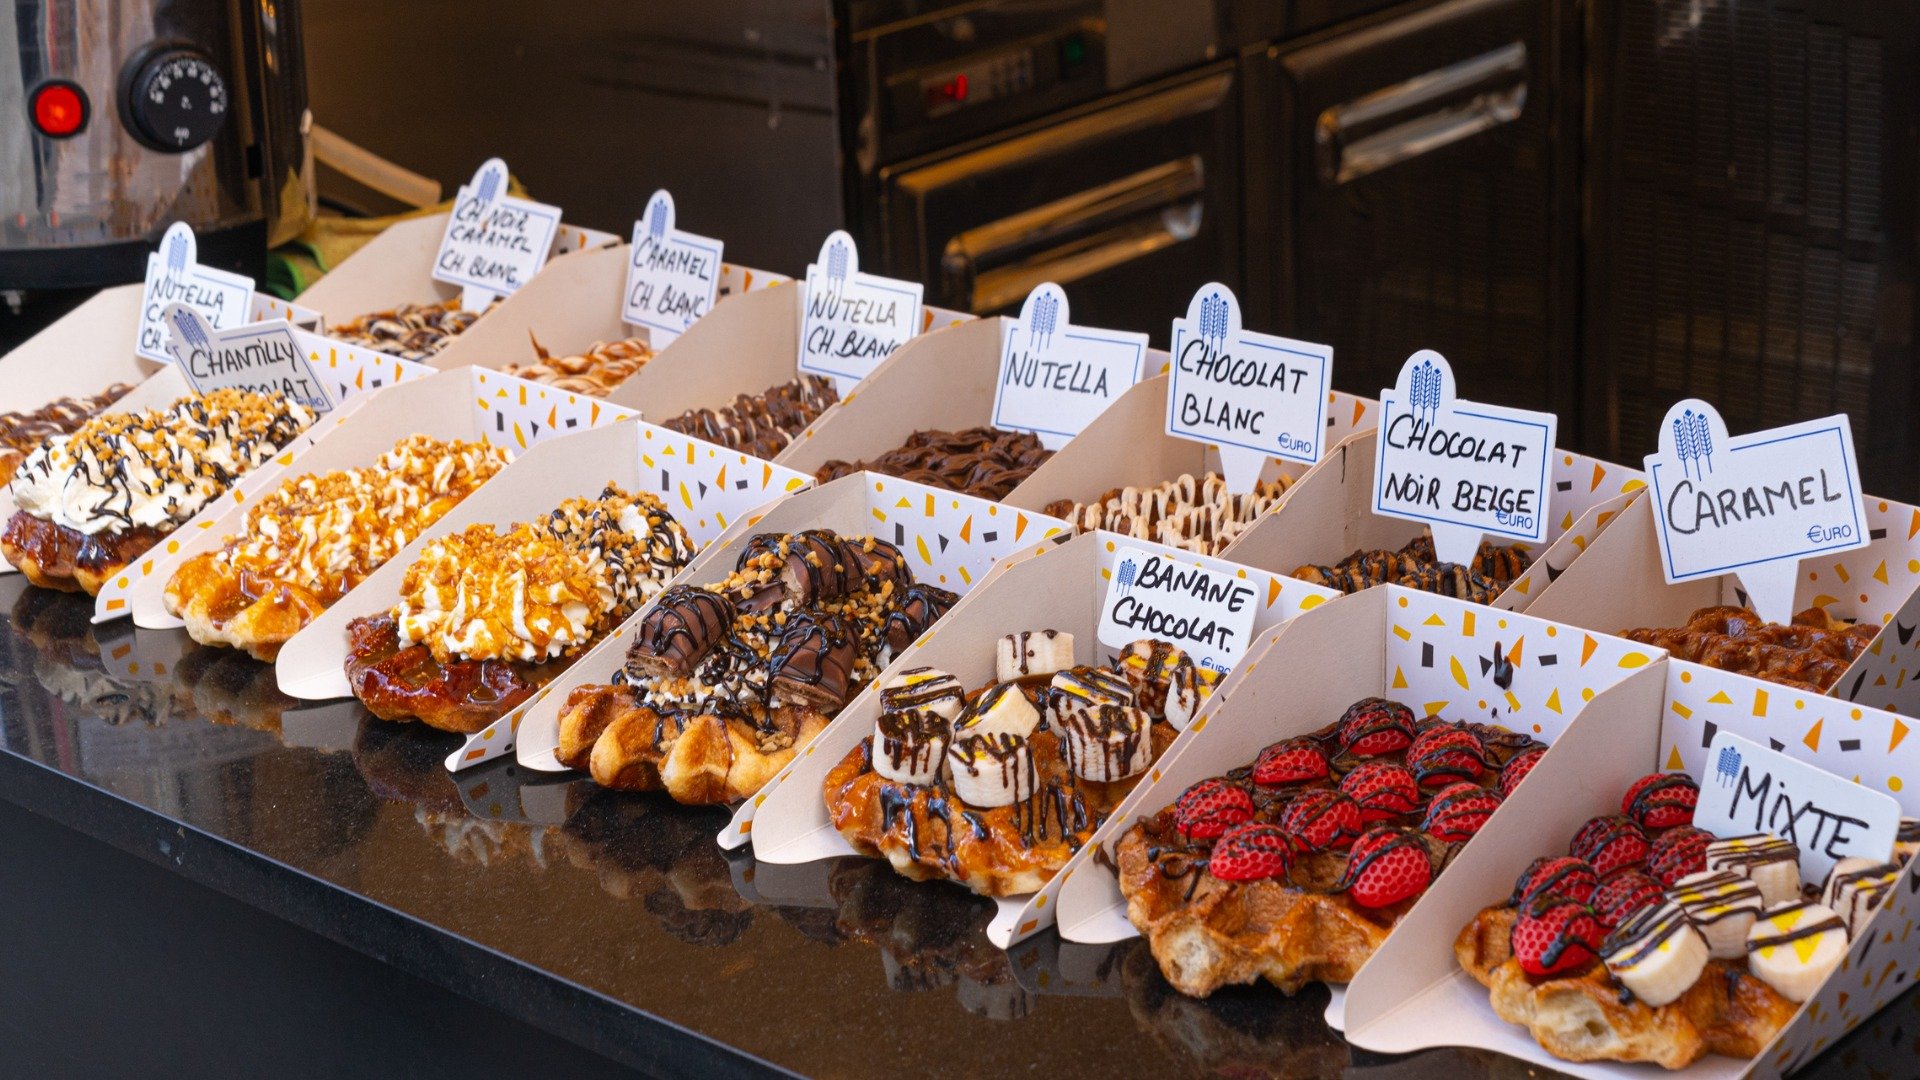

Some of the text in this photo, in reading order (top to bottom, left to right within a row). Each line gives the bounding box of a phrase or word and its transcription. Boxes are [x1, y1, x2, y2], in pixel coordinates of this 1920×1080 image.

[450, 225, 532, 254] CARAMEL
[633, 236, 709, 281] CARAMEL
[468, 255, 517, 283] BLANC
[151, 275, 225, 311] NUTELLA
[656, 284, 705, 318] BLANC
[809, 290, 897, 327] NUTELLA
[1006, 351, 1108, 397] NUTELLA
[1180, 340, 1308, 394] CHOCOLAT
[1181, 393, 1264, 434] BLANC
[1388, 414, 1527, 467] CHOCOLAT
[1452, 480, 1534, 513] BELGE
[1667, 468, 1842, 535] CARAMEL
[1135, 557, 1254, 612] BANANE
[1113, 596, 1234, 653] CHOCOLAT.
